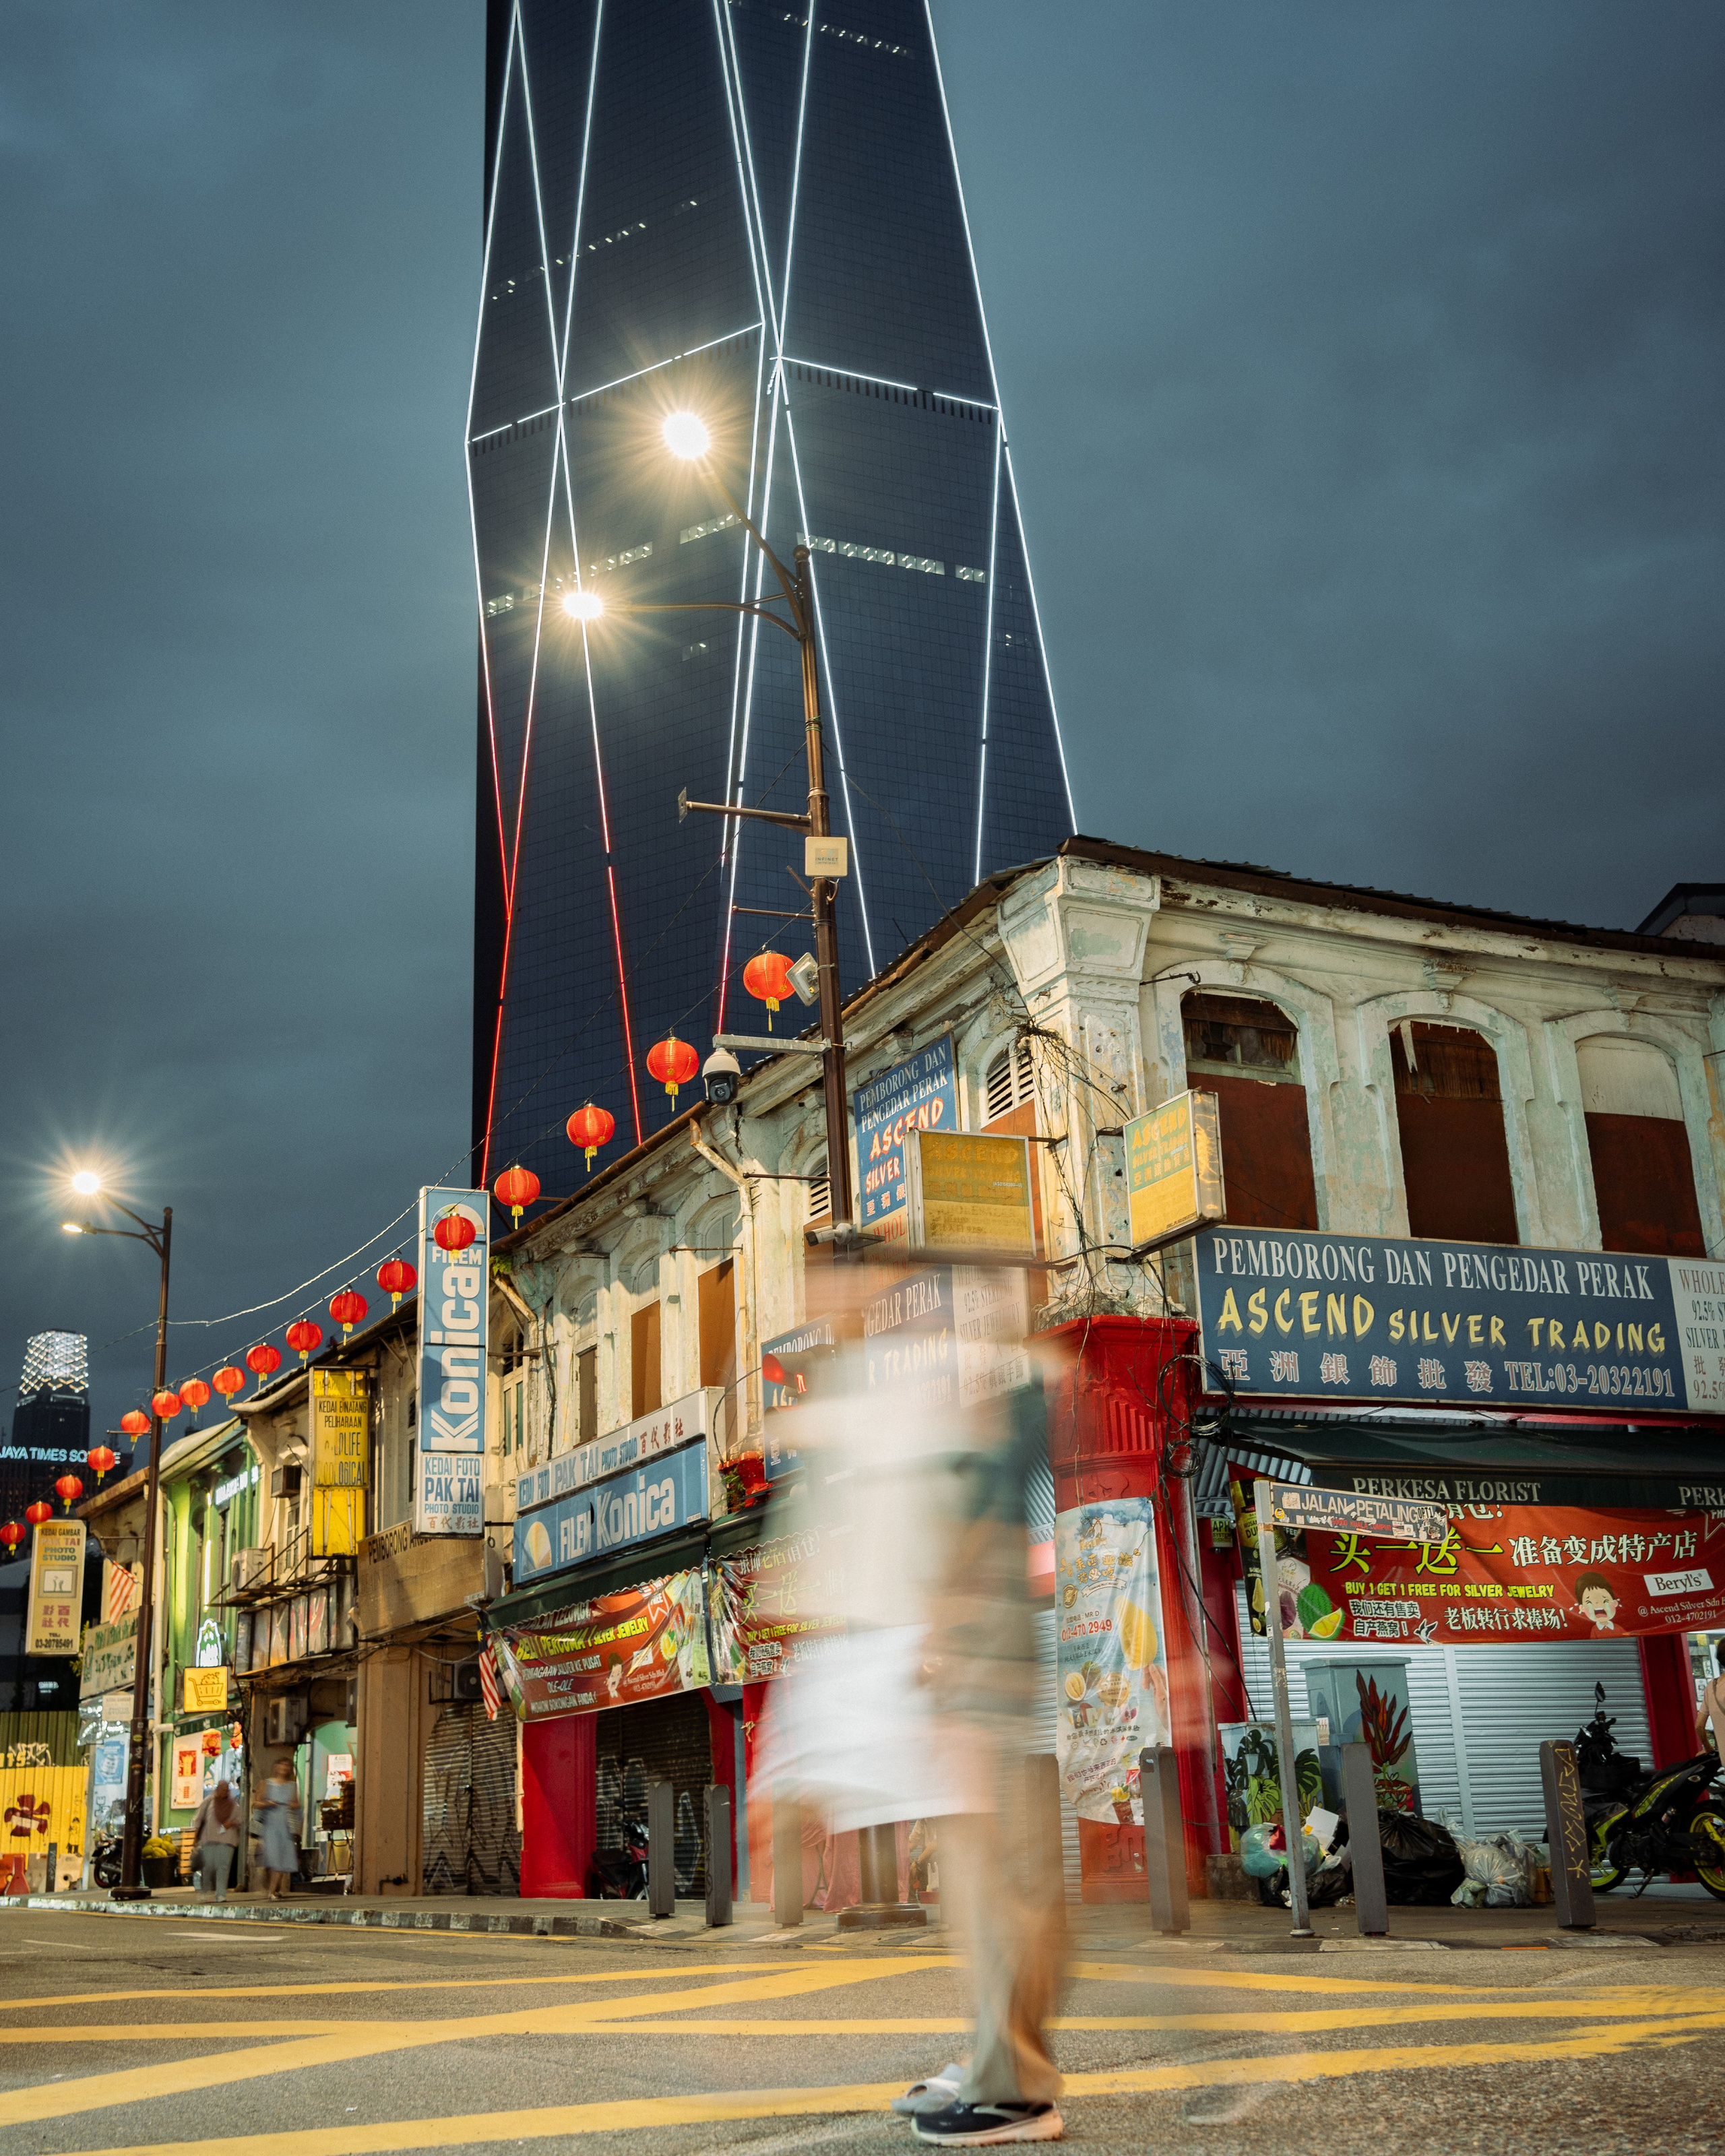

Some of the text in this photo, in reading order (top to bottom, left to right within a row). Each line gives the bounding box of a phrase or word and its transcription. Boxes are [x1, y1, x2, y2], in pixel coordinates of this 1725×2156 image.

[860, 1044, 947, 1112] PEMBORONG DAN
[861, 1067, 949, 1134] PENGEDAR PERAK
[1131, 1106, 1187, 1151] ASCEND
[1132, 1147, 1158, 1169] SILVER
[866, 1155, 901, 1195] SILVER
[1213, 1238, 1654, 1300] PEMBORONG DAN PENGEDAR PERAK
[906, 1273, 942, 1322] PERAK
[1217, 1287, 1665, 1354] ASCEND SILVER TRADING
[1692, 1300, 1716, 1322] 92.5%
[1686, 1327, 1720, 1350] SILVER
[431, 1264, 482, 1452] Konica
[1218, 1349, 1675, 1397] 亞洲銀飾批發 TEL:03-20322191
[319, 1401, 337, 1413] KEDAI
[324, 1416, 362, 1428] PELIHARAAN
[30, 1447, 67, 1462] TIMES
[519, 1417, 684, 1508] KEDAI FOTO PAK TAI PHOTO STUDIO 百代影社
[425, 1457, 480, 1476] KEDAI FOTO
[425, 1478, 479, 1502] PAK TAI
[1352, 1478, 1540, 1502] PERKESA FLORIST
[425, 1503, 479, 1514] PHOTO STUDIO
[596, 1474, 675, 1551] Konica
[1302, 1493, 1418, 1523] JALAN PETALING
[427, 1516, 479, 1530] 百代影社
[1350, 1521, 1369, 1529] KUALA
[1370, 1523, 1391, 1531] LUMPUR
[368, 1526, 408, 1565] PEMBORONG
[1507, 1530, 1698, 1567] 准备变成特产店
[1345, 1581, 1555, 1598] BUY 1 GET 1 FREE FOR SILVER JEWELRY
[1349, 1599, 1421, 1619] 我们还有售卖
[1651, 1603, 1679, 1614] Ascend
[1680, 1599, 1704, 1611] Silver
[1706, 1597, 1720, 1607] Sdn
[617, 1616, 650, 1639] JEWELRY
[774, 1624, 787, 1637] FREE
[787, 1622, 798, 1635] FOR
[799, 1618, 819, 1632] SILVER
[1088, 1618, 1112, 1635] 2949
[1665, 1610, 1717, 1624] 012-4702191
[574, 1659, 584, 1672] KE
[582, 1655, 602, 1670] PUSAT
[547, 1678, 575, 1694] OLE-OLE
[577, 1692, 594, 1706] ANDA
